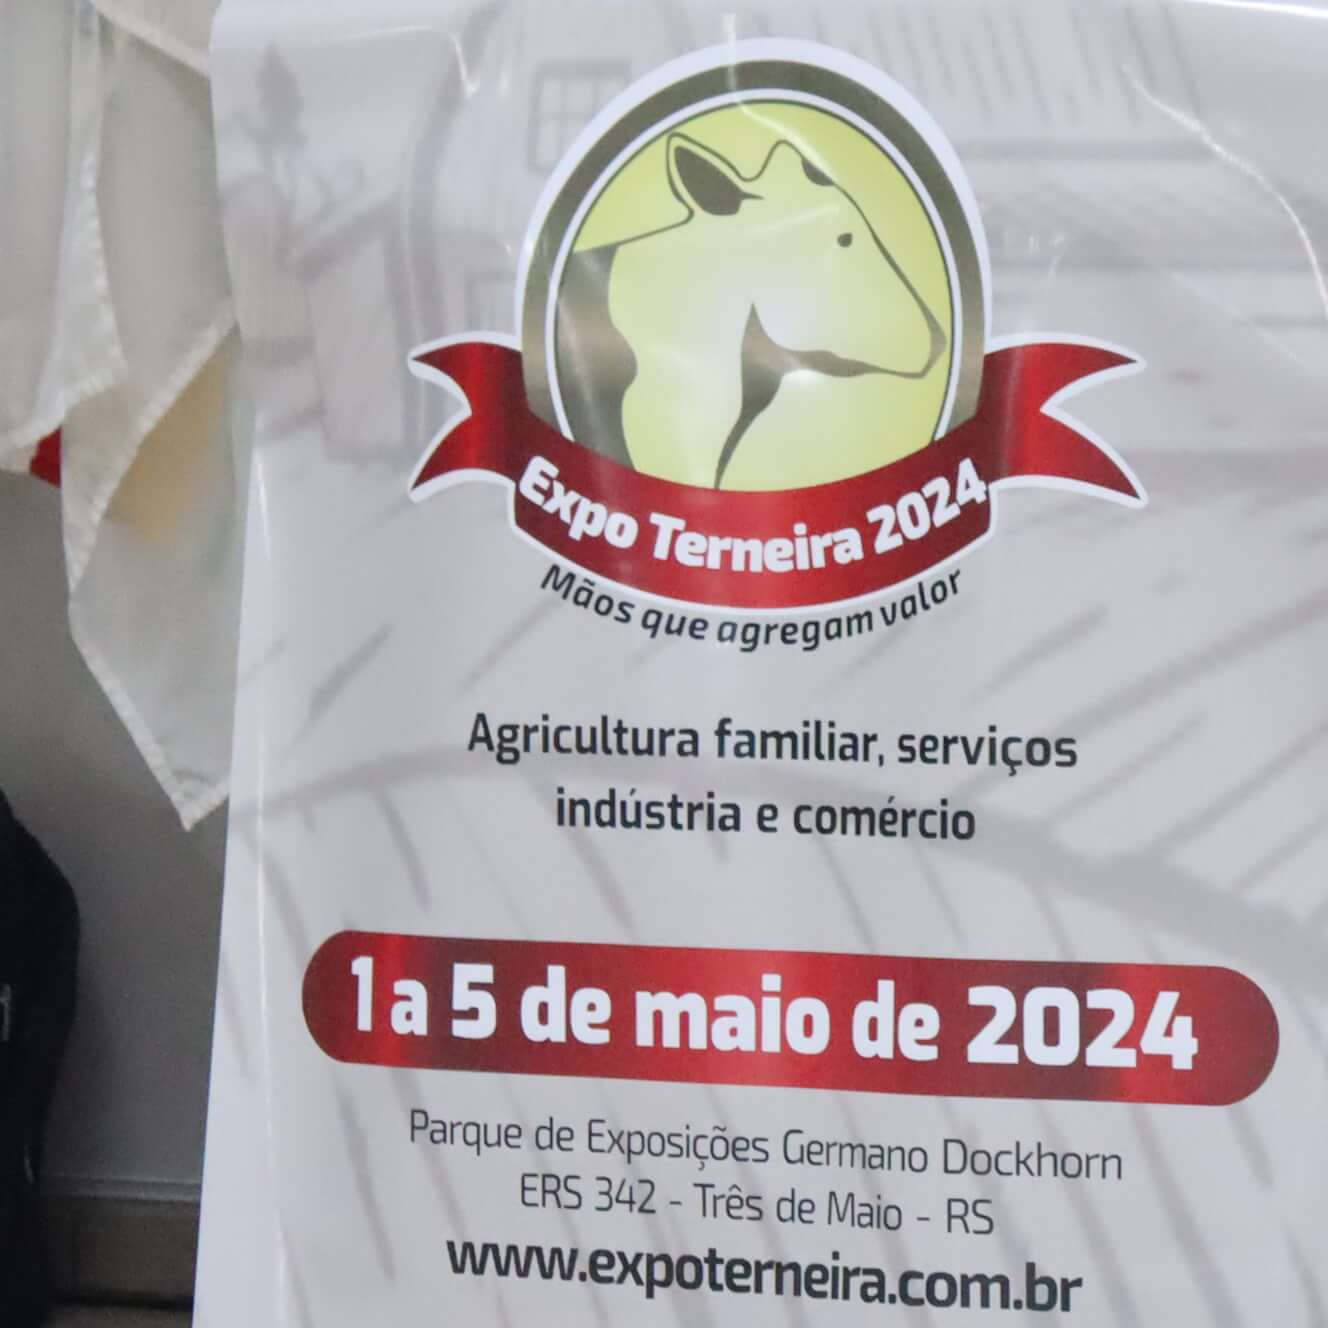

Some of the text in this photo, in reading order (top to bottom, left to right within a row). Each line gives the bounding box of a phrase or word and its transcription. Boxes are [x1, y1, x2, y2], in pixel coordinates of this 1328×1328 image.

[519, 455, 988, 572] Expo Terneira 2024
[540, 564, 961, 653] Mãos que agregam valor
[467, 712, 1077, 773] Agricultura familiar, serviços
[556, 786, 976, 841] indústria e comércio
[351, 956, 1199, 1070] 1 a 5 de maio de 2024
[410, 1107, 1122, 1180] Parque de Exposições Germano Dockhorn
[520, 1172, 583, 1211] ERS
[594, 1175, 657, 1215] 342
[692, 1182, 764, 1223] Três
[776, 1187, 816, 1225] de
[827, 1190, 903, 1232] Maio
[946, 1197, 995, 1235] RS
[446, 1240, 1083, 1313] www.expoterneira.com.br
